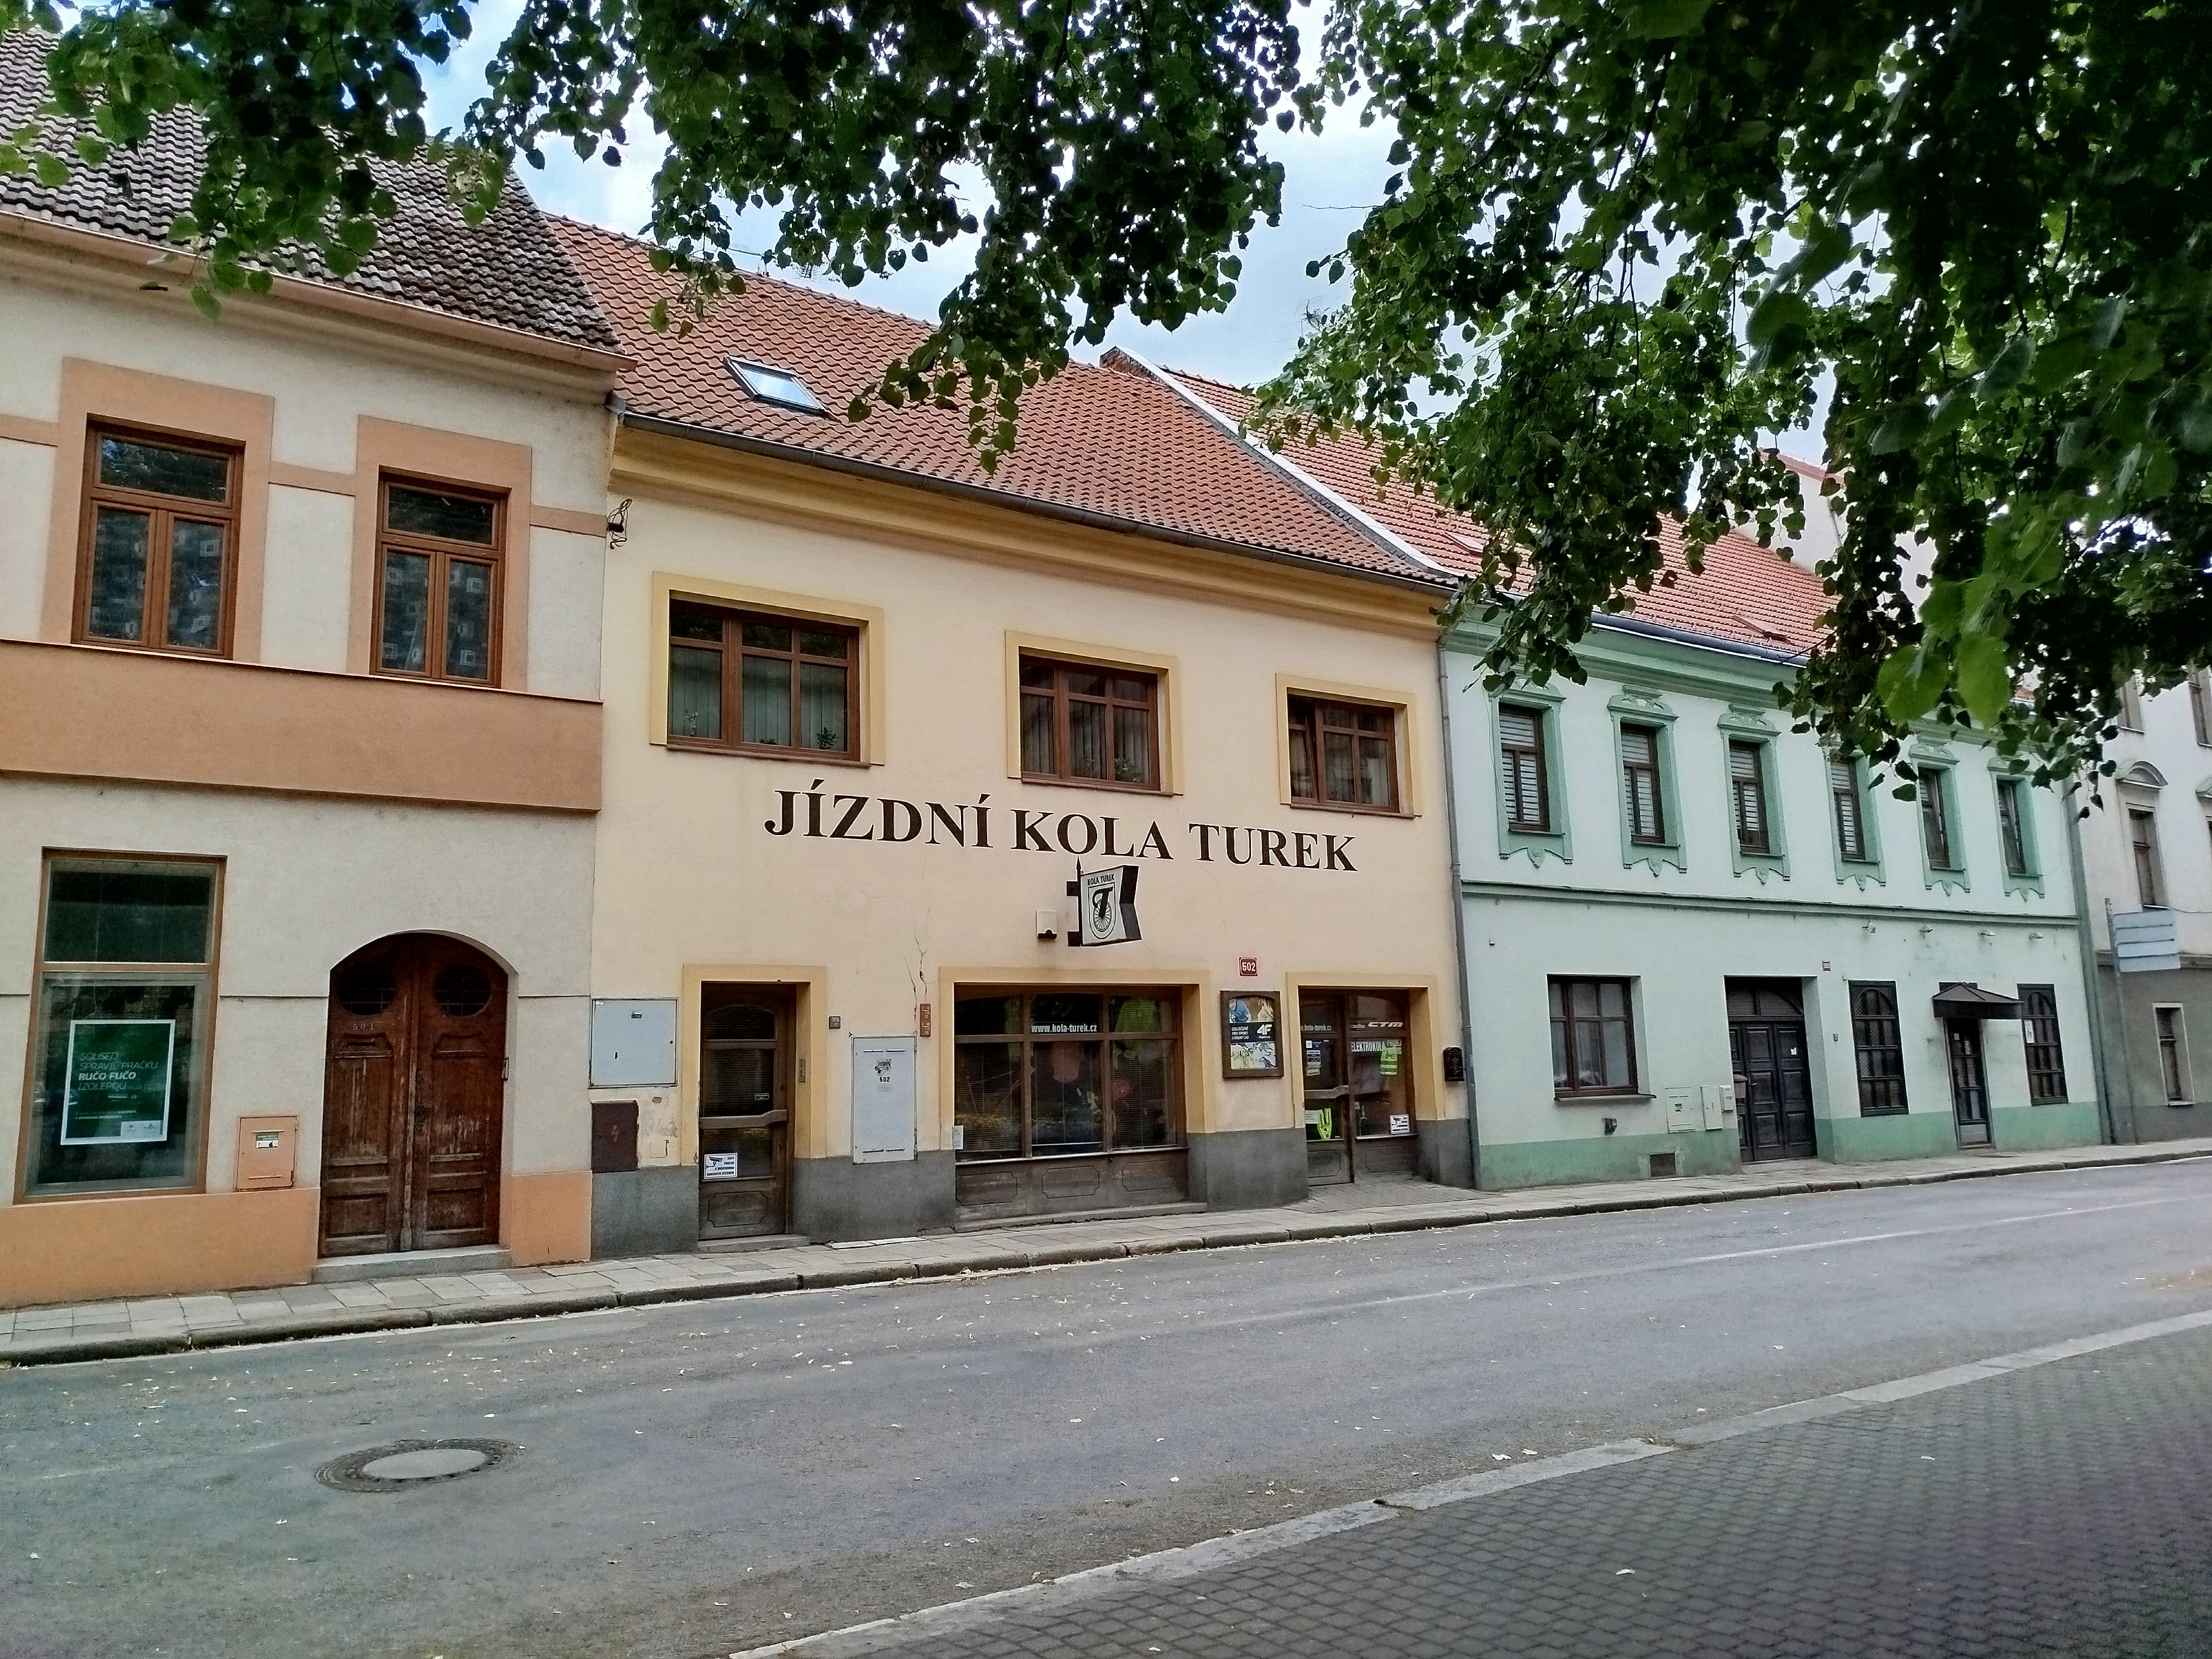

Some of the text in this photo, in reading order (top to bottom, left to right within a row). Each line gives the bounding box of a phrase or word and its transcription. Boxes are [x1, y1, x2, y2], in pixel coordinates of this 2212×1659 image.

[764, 779, 1358, 872] JÍZDNÍ KOLA TUREK
[1087, 873, 1115, 886] KOLA TUREK
[1242, 962, 1256, 972] 502
[1031, 1024, 1097, 1032] www.kola-turek.cz
[1257, 1024, 1272, 1035] 4F
[1351, 1041, 1386, 1052] ELEKTROKOLA
[80, 1052, 118, 1061] SOUSED
[80, 1060, 158, 1070] SPRAVIL PRAČKU
[78, 1070, 137, 1080] RUČO FUČO
[77, 1082, 127, 1091] IZOLEPOU
